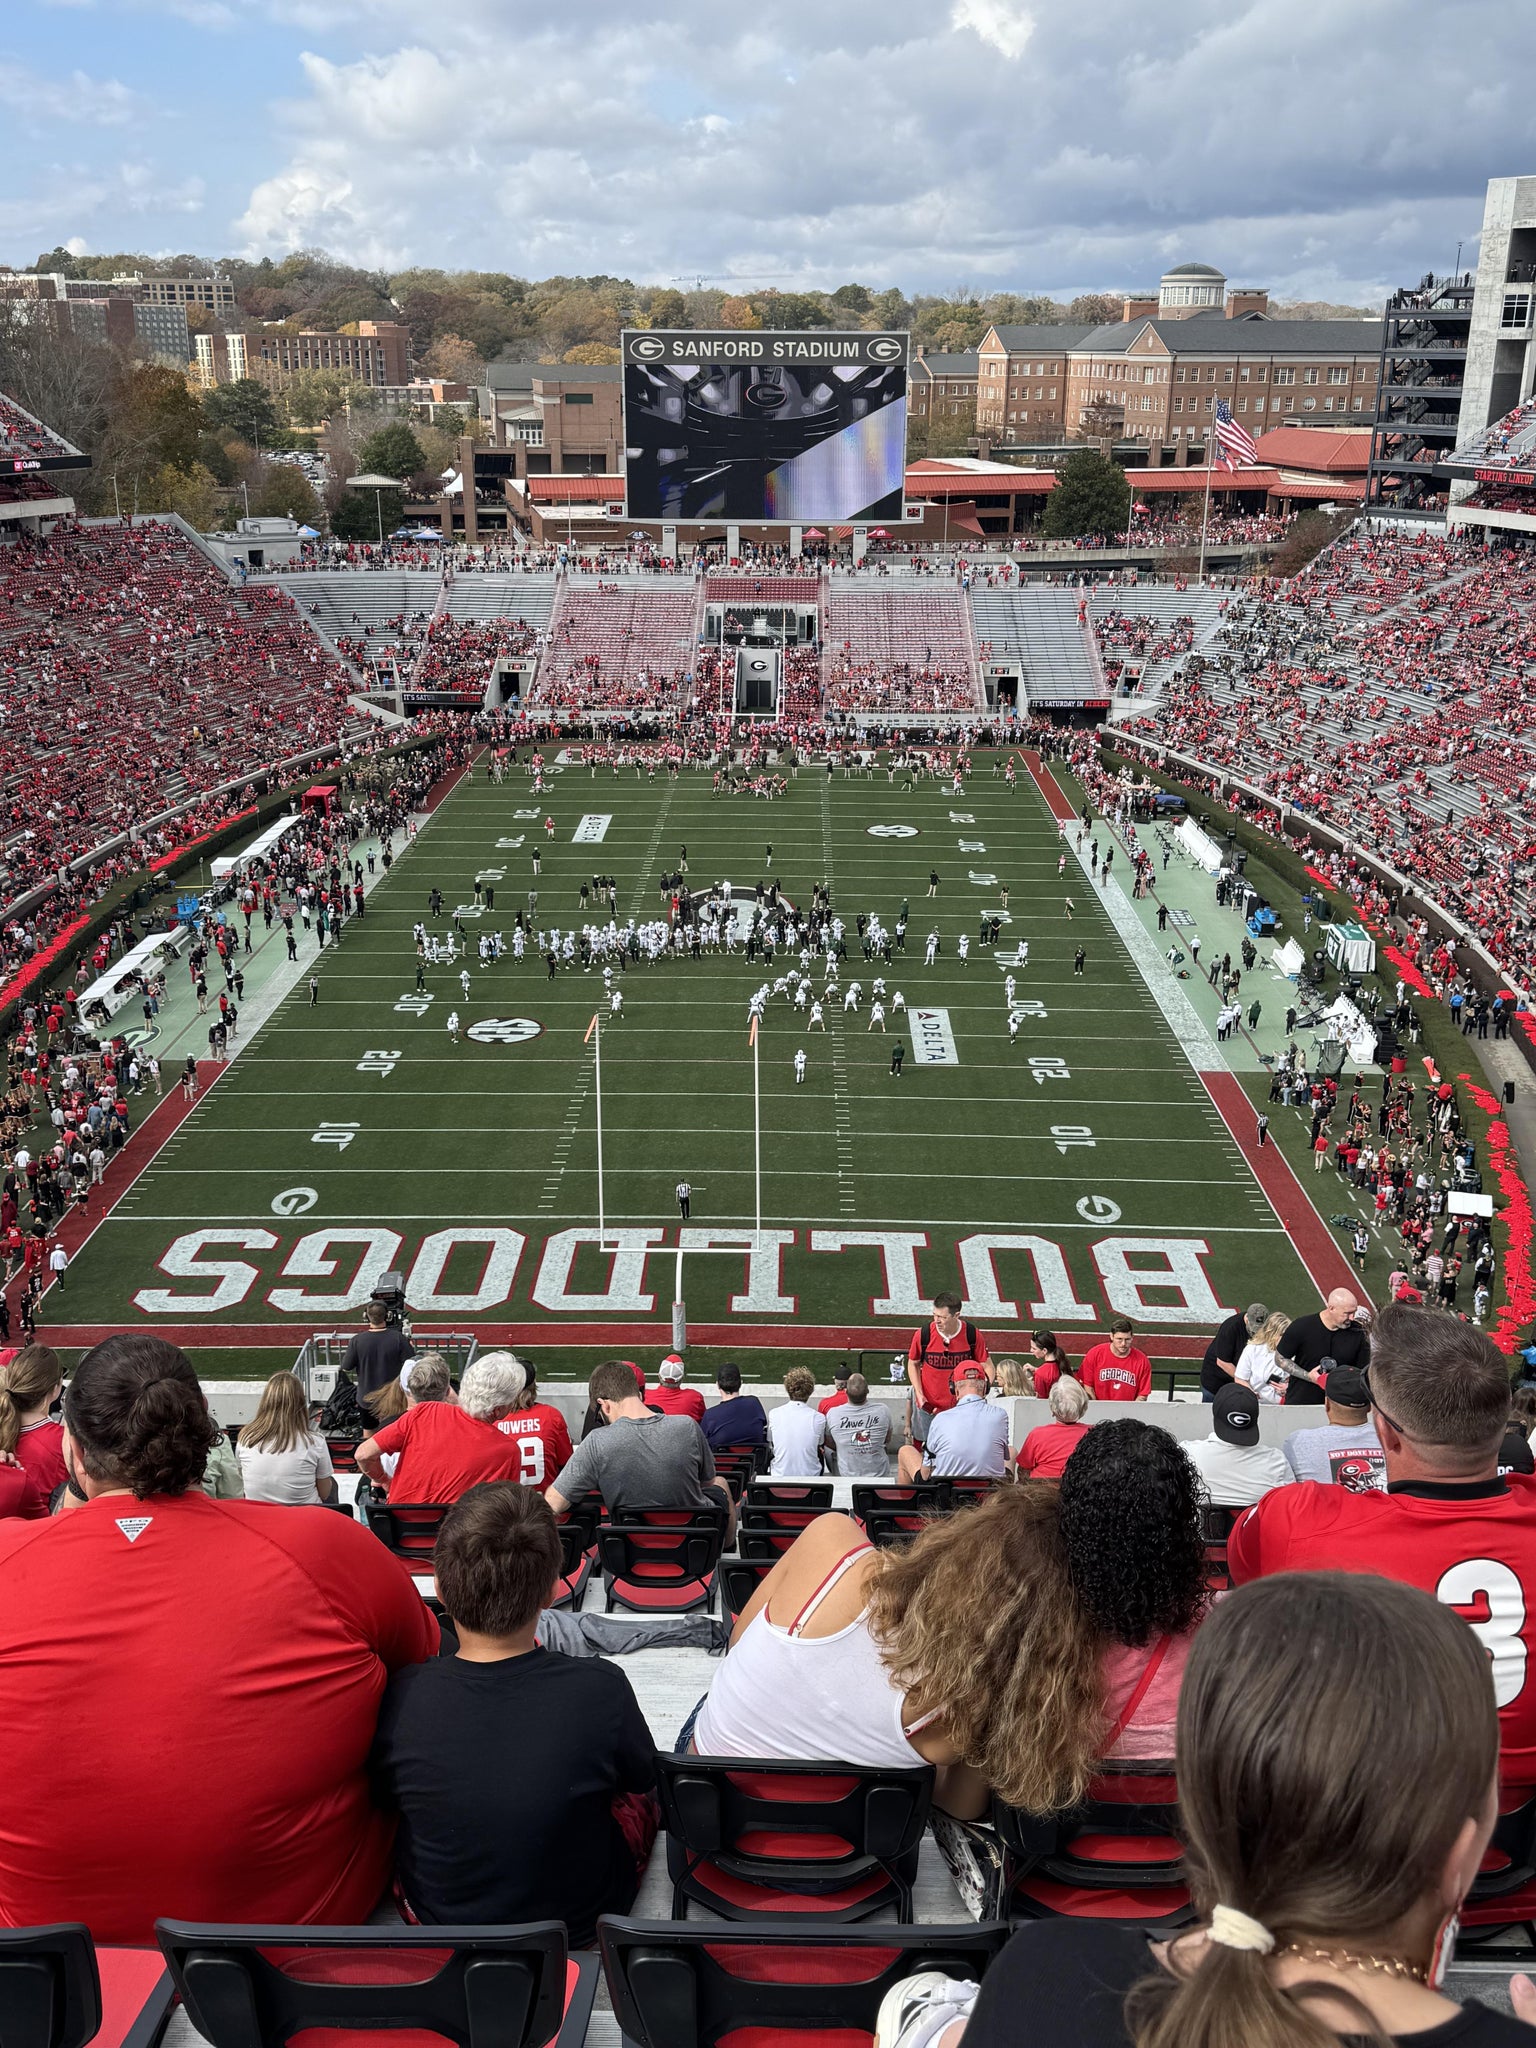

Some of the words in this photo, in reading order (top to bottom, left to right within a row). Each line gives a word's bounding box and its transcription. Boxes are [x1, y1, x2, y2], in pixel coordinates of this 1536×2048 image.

[672, 340, 764, 357] SANFORD
[772, 340, 860, 358] STADIUM
[1474, 469, 1507, 482] STARTING
[1508, 472, 1535, 485] LINEUP
[393, 993, 435, 1011] 30
[921, 1023, 947, 1062] DELTA
[355, 1050, 403, 1071] 20
[1027, 1057, 1072, 1079] 20
[310, 1122, 361, 1143] 10
[1049, 1125, 1097, 1147] 10
[270, 1186, 319, 1216] G
[1075, 1194, 1122, 1224] G
[131, 1227, 1241, 1325] BULLDOGS
[1099, 1367, 1137, 1387] GEORGIA
[1434, 1557, 1529, 1711] 3
